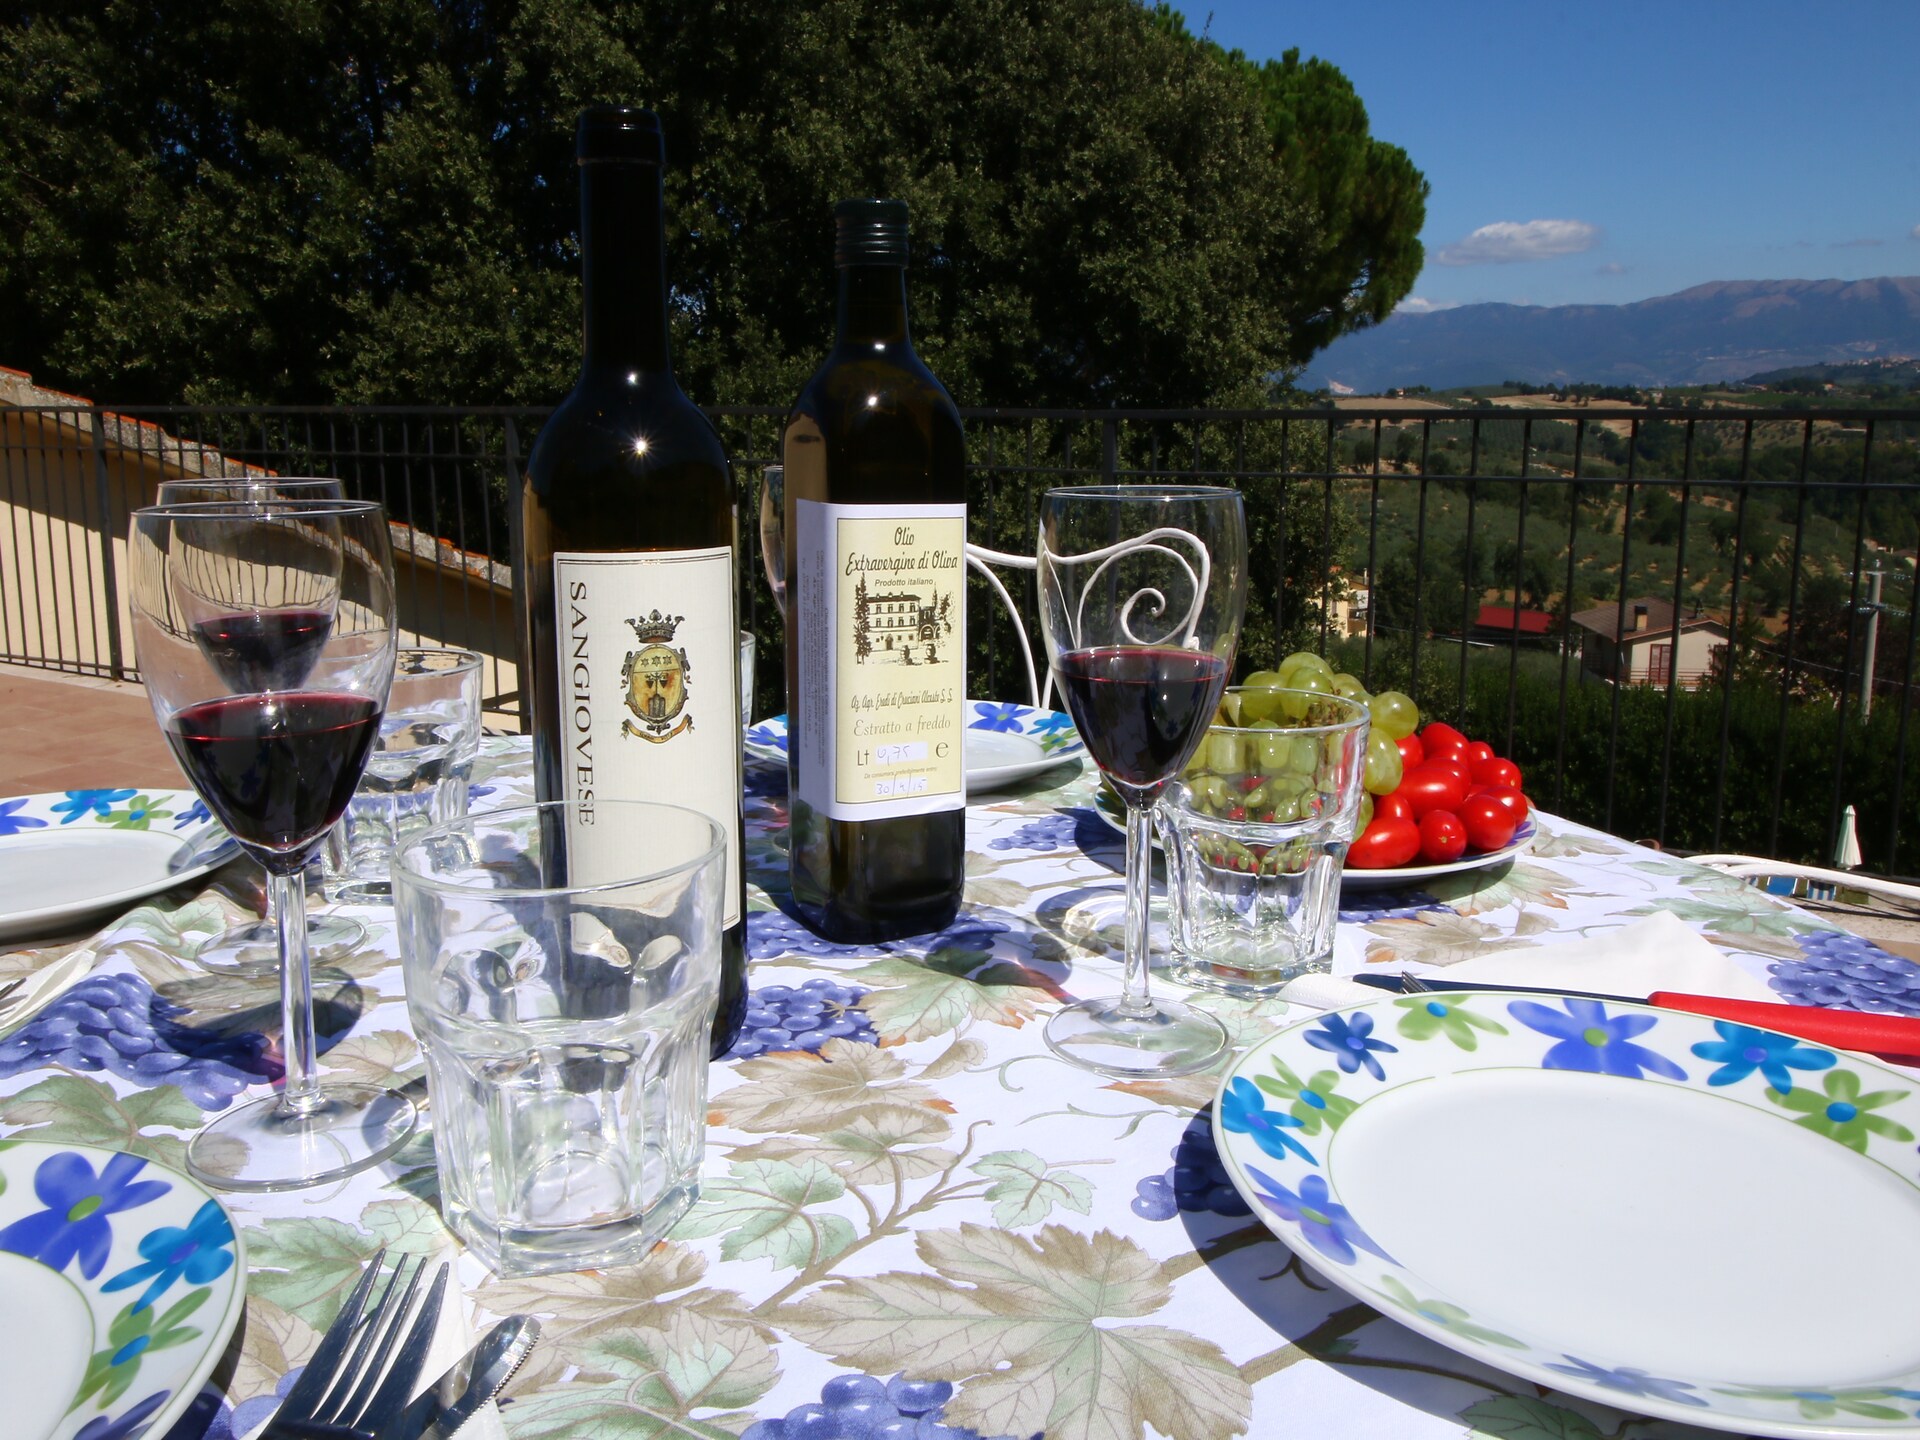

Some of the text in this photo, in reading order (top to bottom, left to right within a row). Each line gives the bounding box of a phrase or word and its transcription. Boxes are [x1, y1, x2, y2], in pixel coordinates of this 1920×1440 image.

[894, 526, 915, 546] Olio
[845, 550, 958, 576] Extravergine di Oliva
[874, 578, 934, 587] Prodotto italiano
[569, 581, 595, 826] SANGIOVESE
[853, 714, 951, 737] Estratto a freddo
